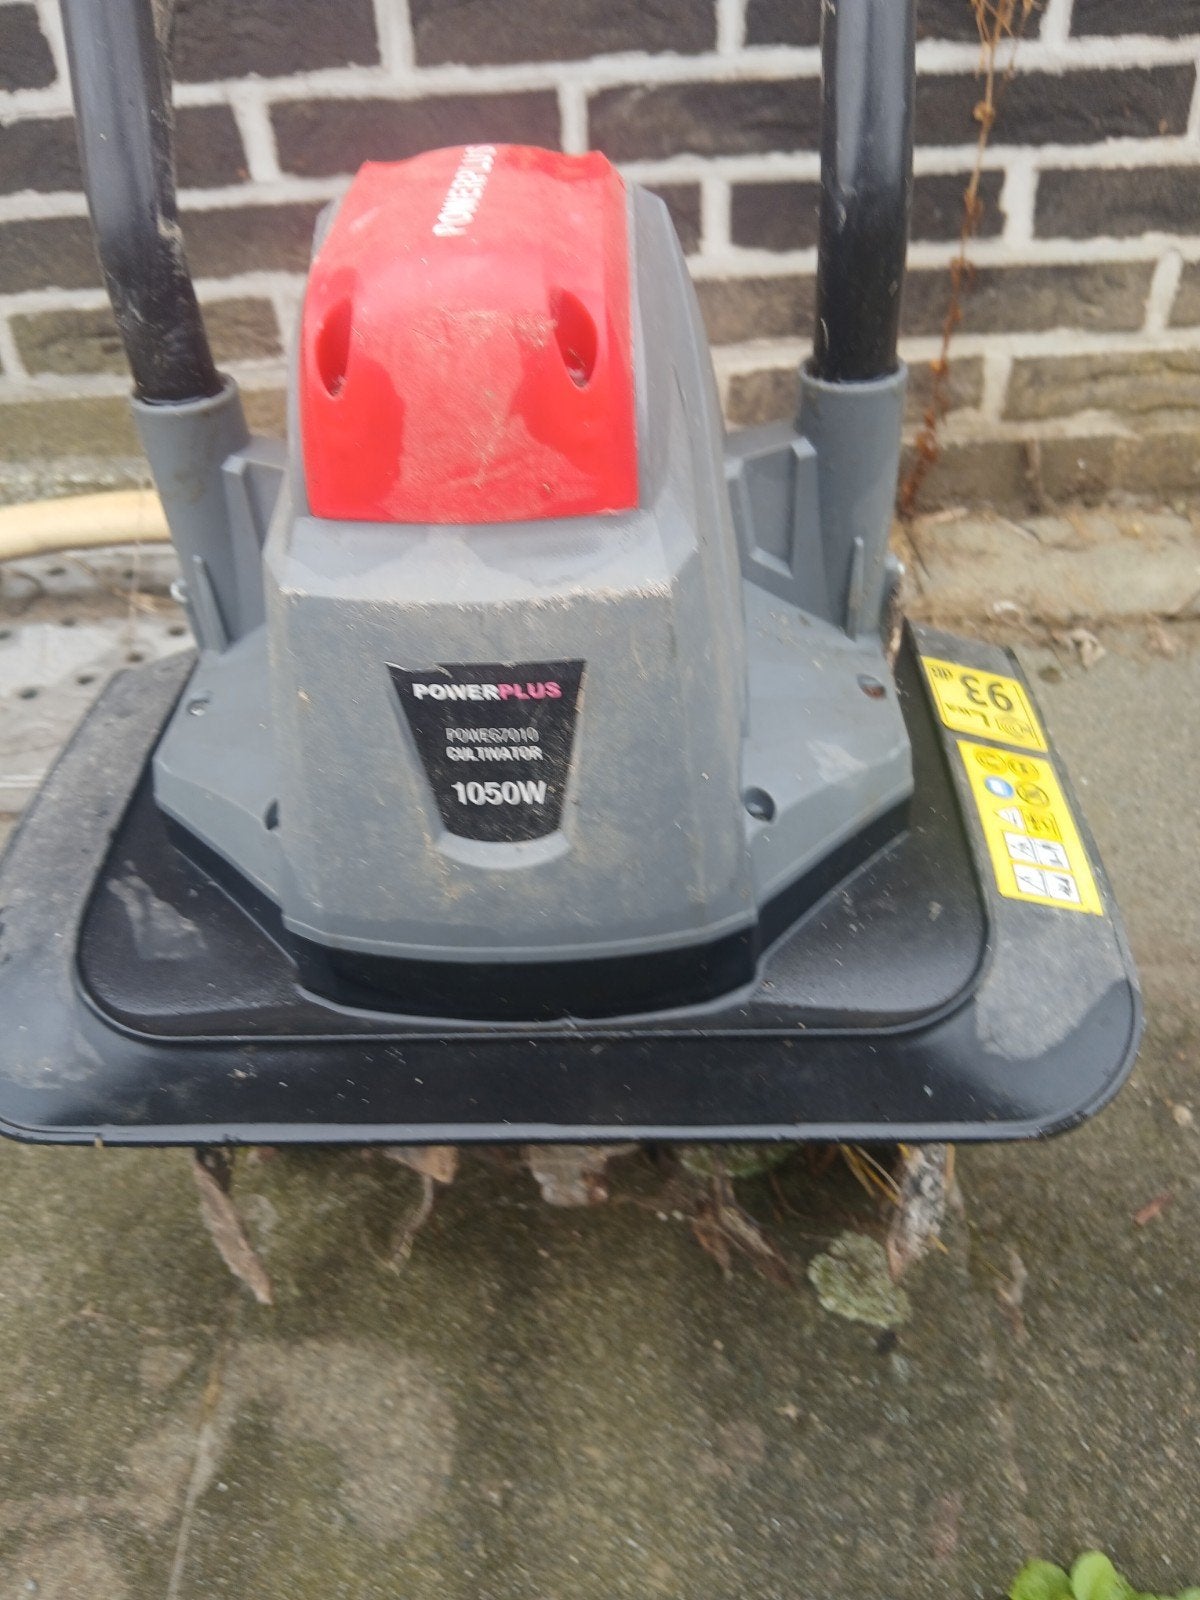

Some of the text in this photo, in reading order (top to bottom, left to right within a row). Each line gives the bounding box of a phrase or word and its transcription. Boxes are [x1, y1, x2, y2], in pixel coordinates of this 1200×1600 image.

[412, 681, 563, 701] POWERPLUS
[959, 674, 1014, 712] 93
[445, 745, 545, 762] CULTIVATOR
[450, 779, 548, 806] 1050W
